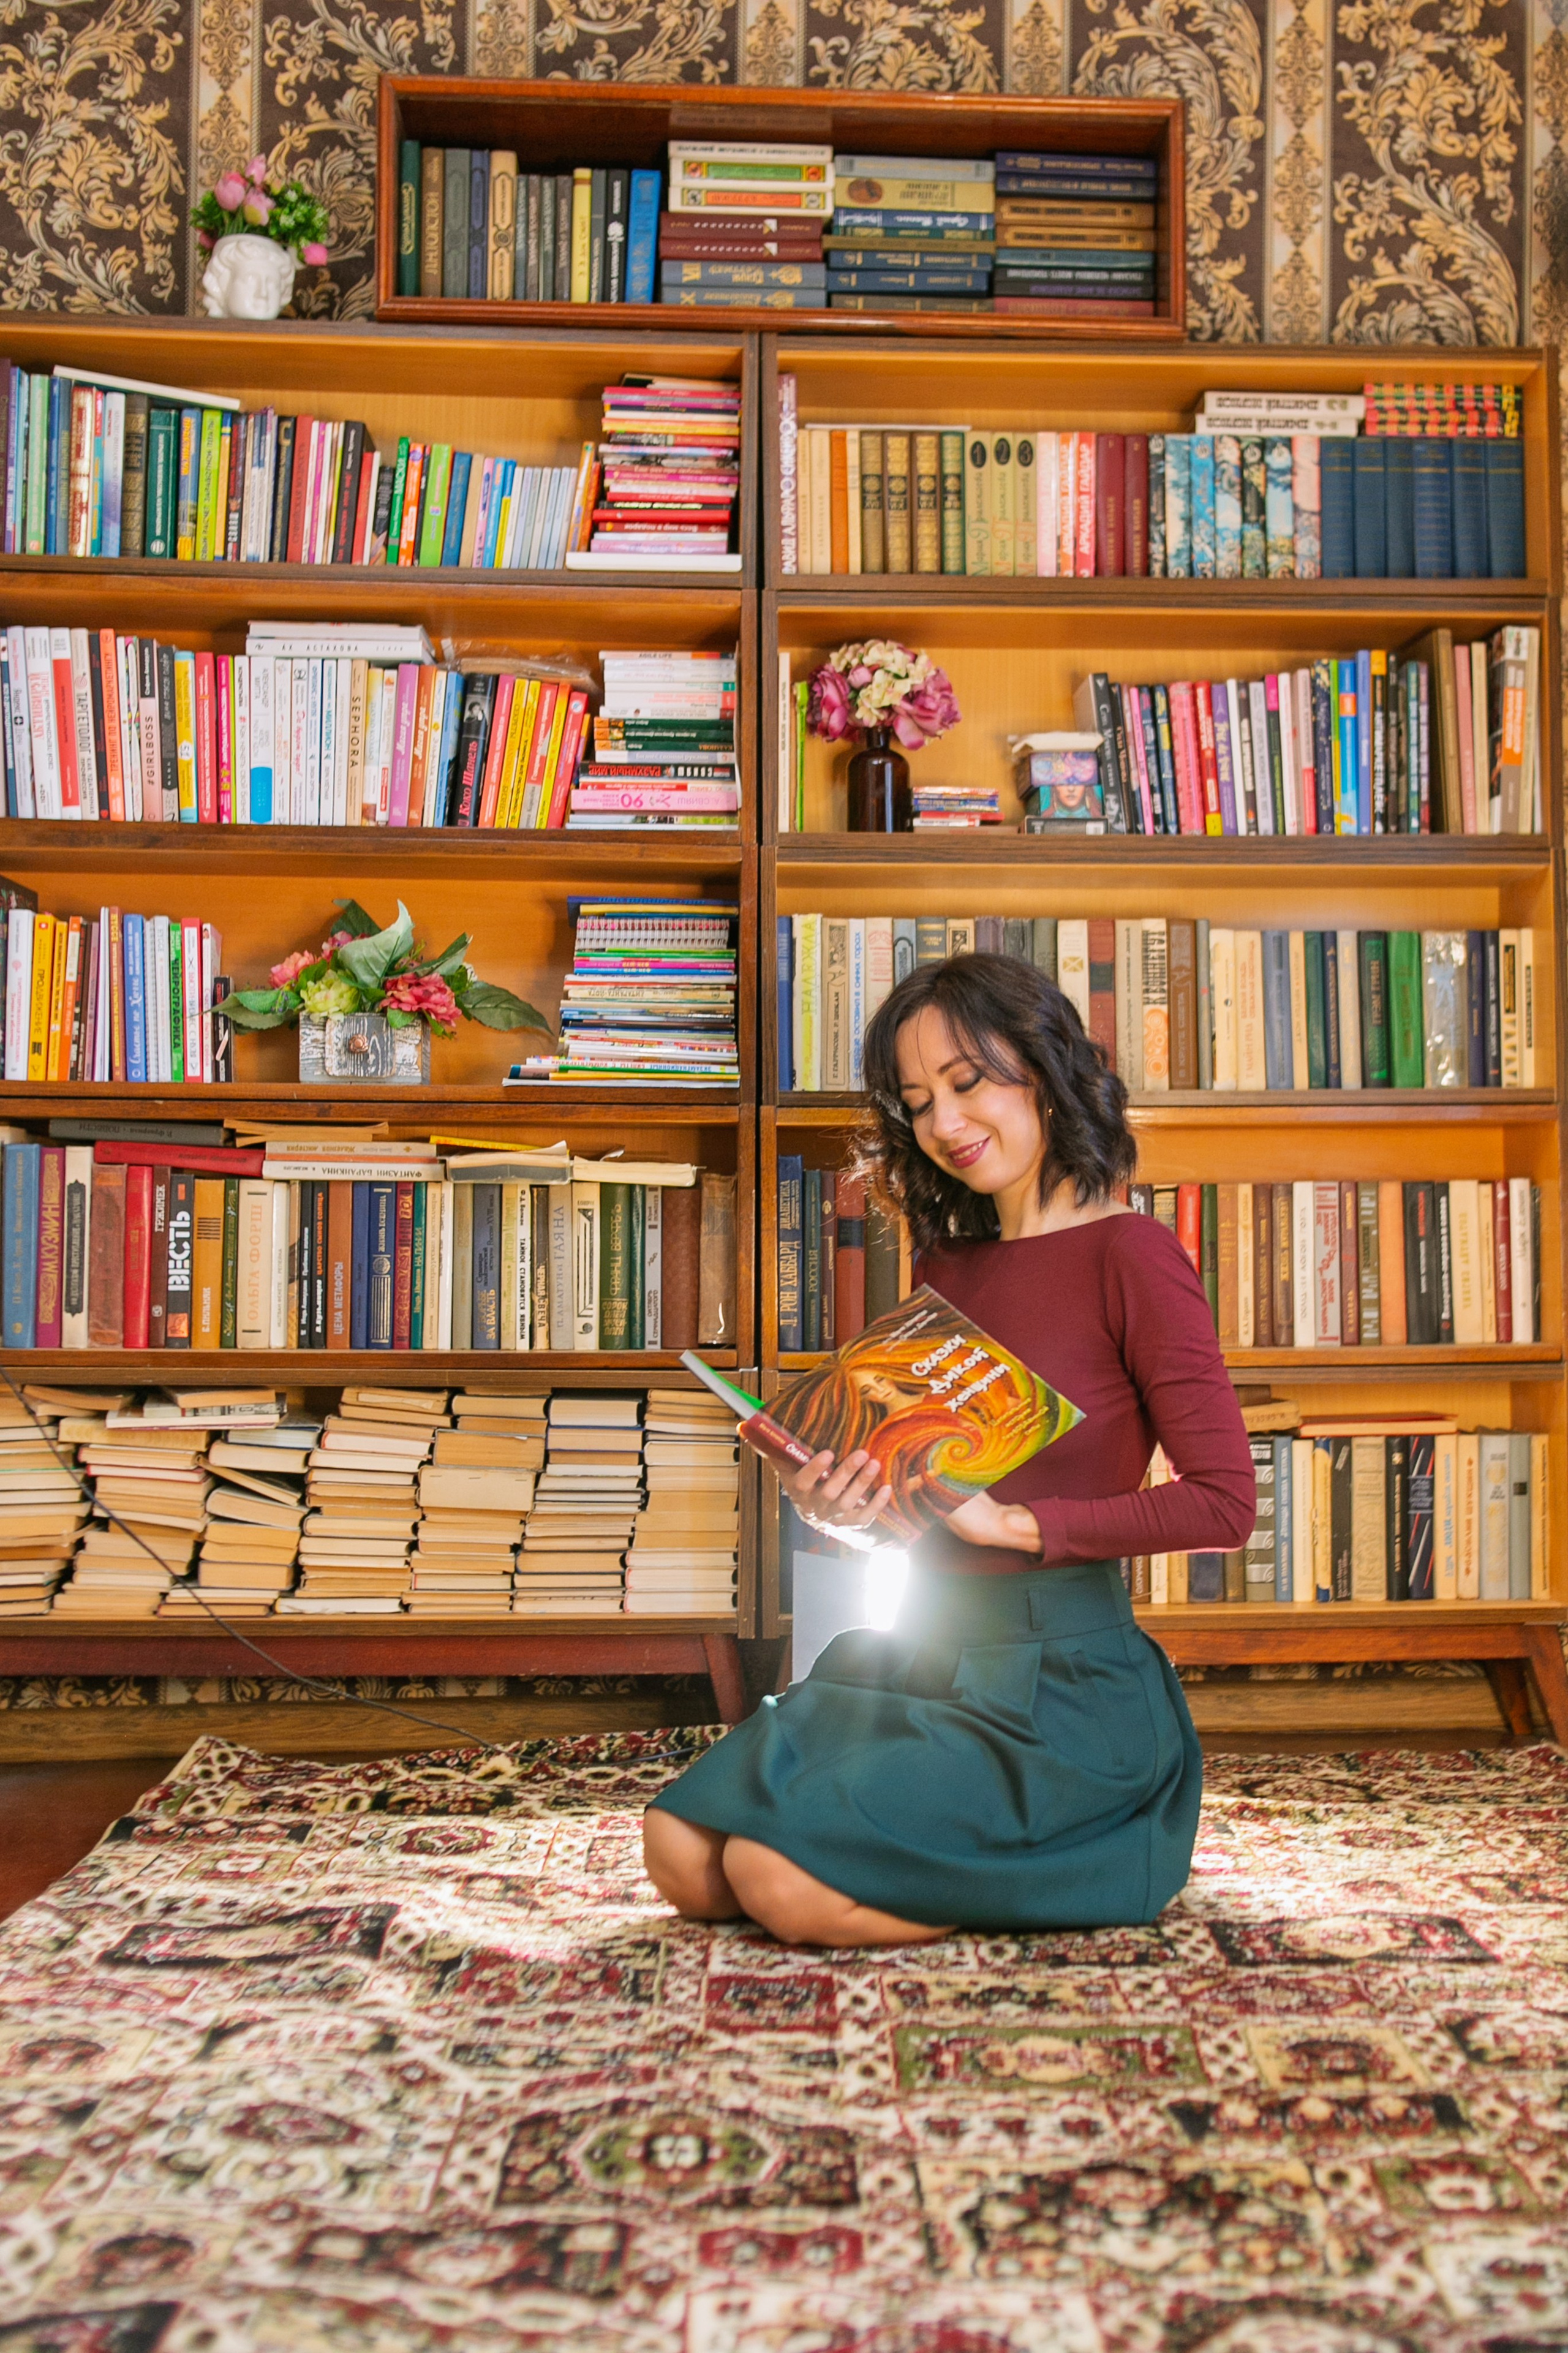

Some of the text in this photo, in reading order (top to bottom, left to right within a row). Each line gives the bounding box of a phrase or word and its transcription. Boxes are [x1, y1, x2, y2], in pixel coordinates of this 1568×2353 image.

[75, 692, 91, 754] ТАРГЕТОЛОГ
[350, 696, 361, 768] SEPHORA
[145, 715, 155, 785] #GIRLBOSS
[588, 766, 609, 775] МИР
[611, 766, 662, 777] РАЗУМНЫЙ
[459, 741, 478, 816] Коко Шанель
[620, 793, 644, 807] 90
[34, 968, 45, 1034] ПРОДВИЖЕНИЕ
[322, 1168, 373, 1176] БАРАНКИНА
[155, 1184, 165, 1233] ГРЖИМЕК
[315, 1192, 324, 1224] СОЛНЦА
[377, 1195, 387, 1253] ЖИЗНЬ ЕСЕНИНА
[779, 1179, 792, 1230] ДИАНЕТИКА
[39, 1203, 60, 1273] М.КУЗМИН
[167, 1210, 191, 1291] ВЕСТЬ
[315, 1225, 324, 1245] СЫНОВ
[552, 1205, 565, 1260] ГАЯНА
[609, 1203, 622, 1296] ФРАНЦ ВЕРФЕЛЬ
[247, 1204, 262, 1321] ОЛЬГА ФОРШ
[315, 1246, 324, 1275] ЦАРСТВО
[779, 1241, 802, 1287] ХАББАРД
[807, 1248, 820, 1293] РОССИЯ
[333, 1261, 344, 1335] ЦЕНА МЕТАФОРЫ
[486, 1290, 496, 1340] ЗА ВЛАСТЬ
[537, 1298, 546, 1328] СВЕЧА
[780, 1291, 799, 1312] РОН
[911, 1334, 967, 1378] Сказки
[928, 1346, 989, 1396] Дикой
[943, 1362, 1011, 1413] женщины
[785, 1443, 812, 1464] Сказк
